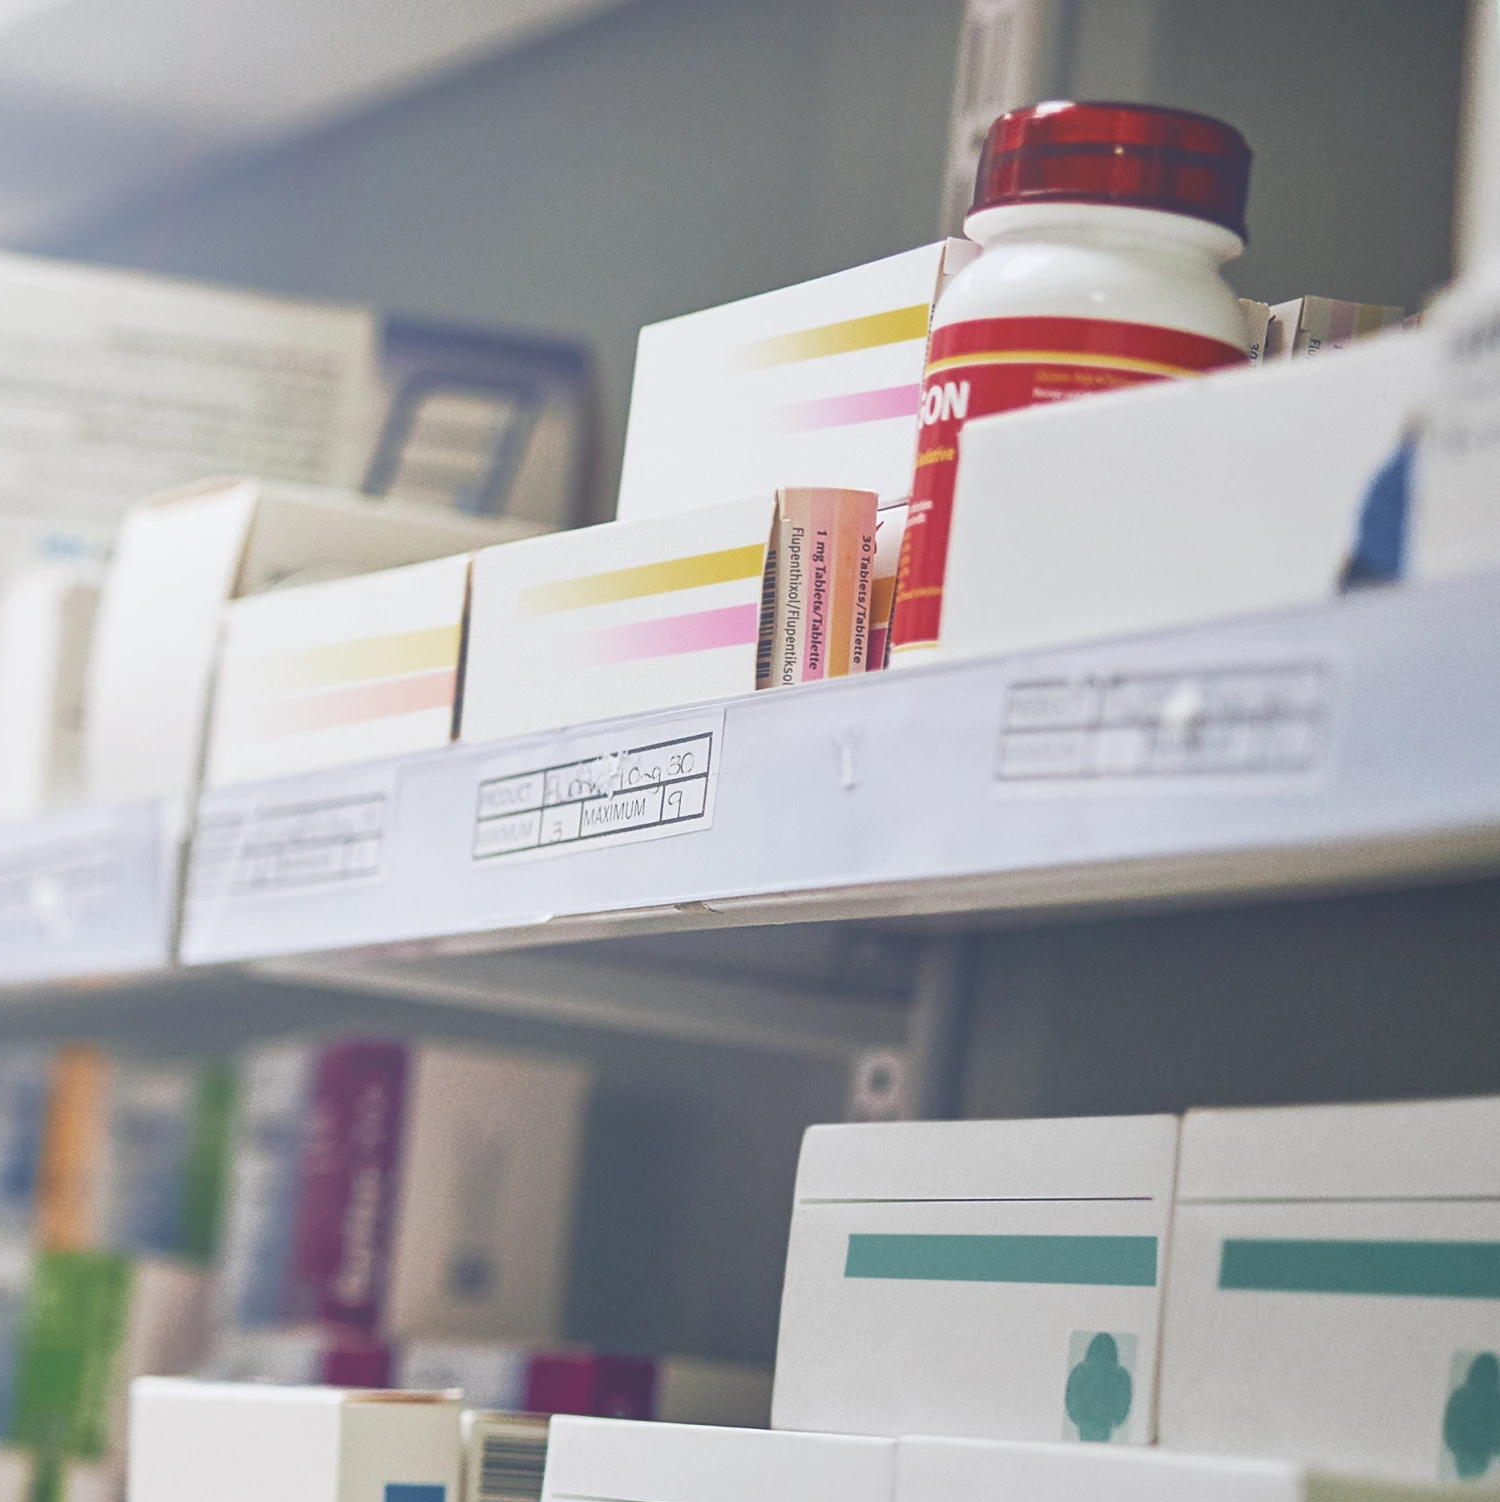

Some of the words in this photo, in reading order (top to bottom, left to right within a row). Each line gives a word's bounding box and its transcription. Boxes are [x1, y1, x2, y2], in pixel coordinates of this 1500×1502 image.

[811, 541, 826, 562] mg
[861, 535, 872, 553] 30
[782, 526, 805, 686] Flupenthixol/Flupentiksol
[808, 565, 827, 670] Tablets/Tablette
[852, 556, 871, 664] Tablets/Tablette
[666, 752, 695, 774] 30
[583, 798, 647, 827] MAXIMUM
[668, 790, 683, 818] 9
